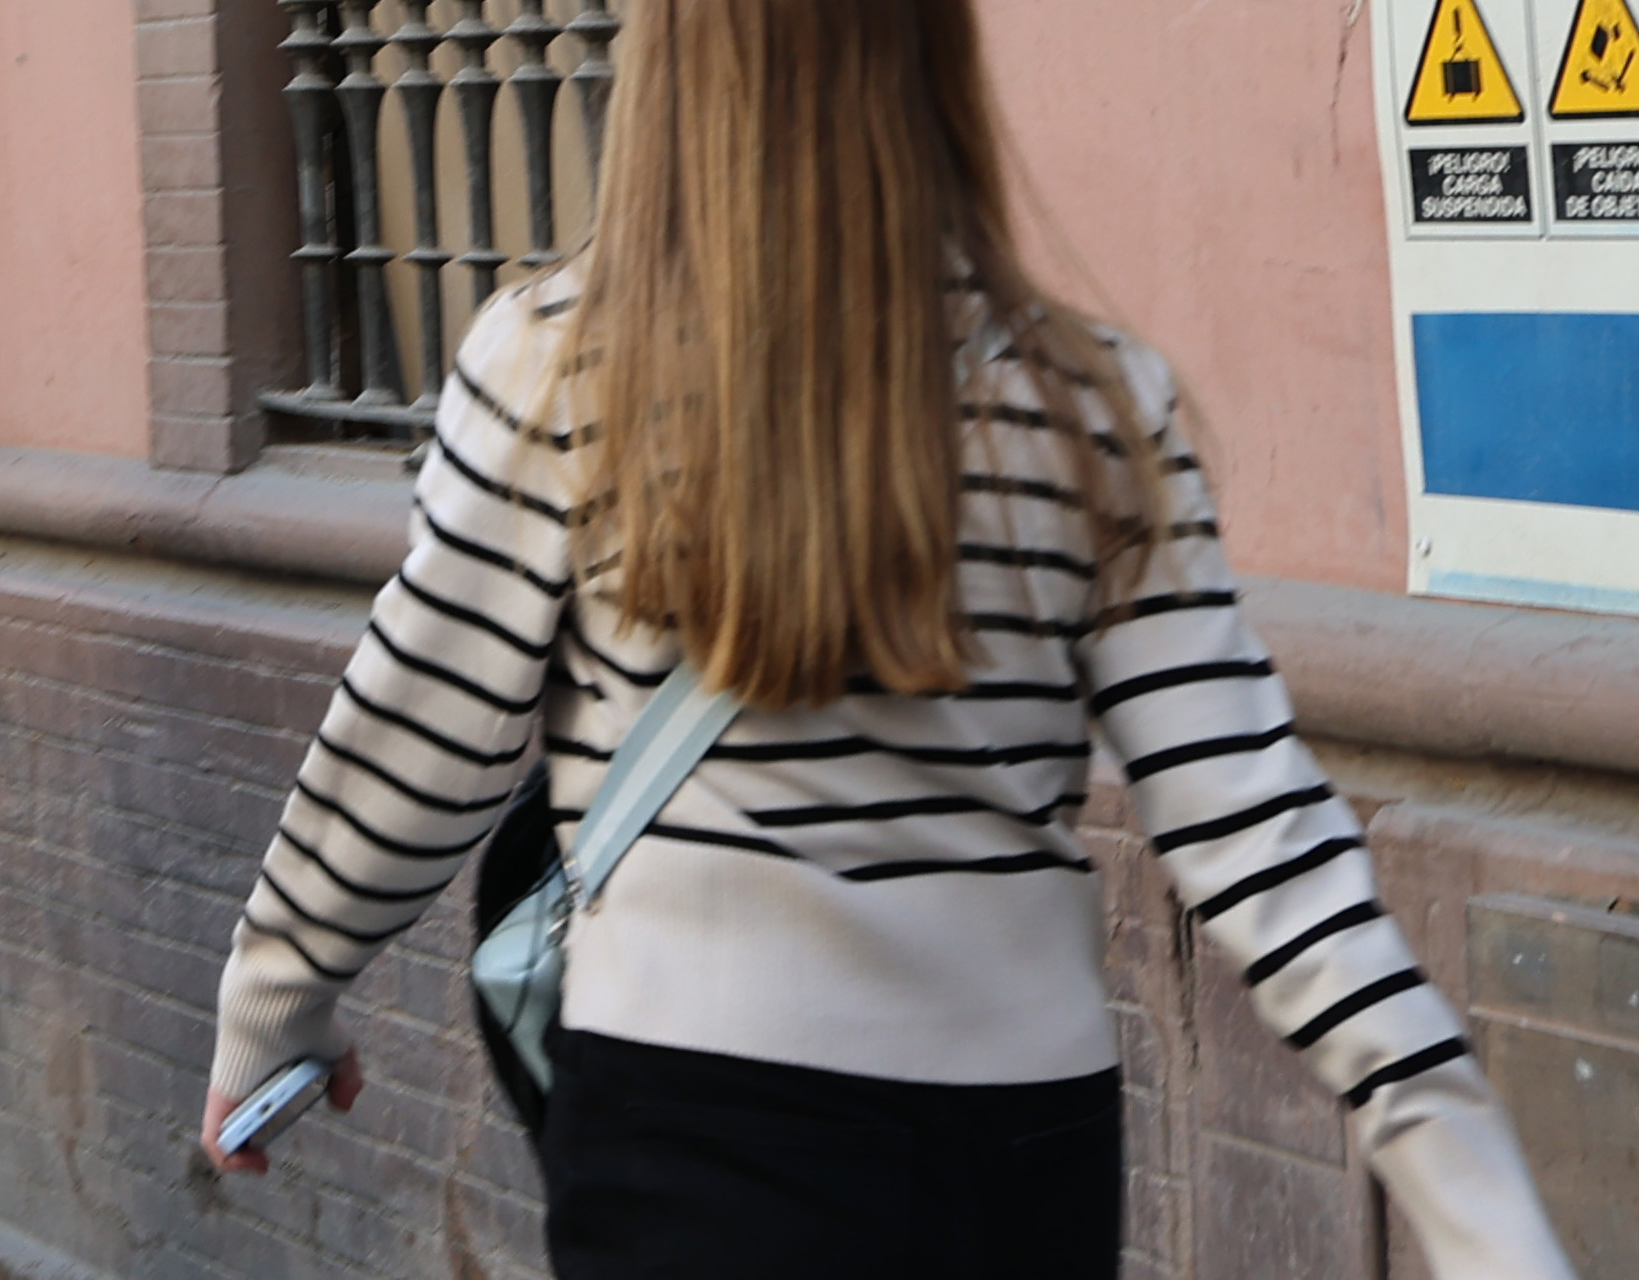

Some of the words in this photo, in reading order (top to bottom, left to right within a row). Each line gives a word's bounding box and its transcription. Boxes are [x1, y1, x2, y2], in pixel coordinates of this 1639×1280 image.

[1442, 174, 1504, 196] CARGA
[1421, 195, 1527, 221] SUSPENDIDA
[1565, 197, 1590, 222] DE
